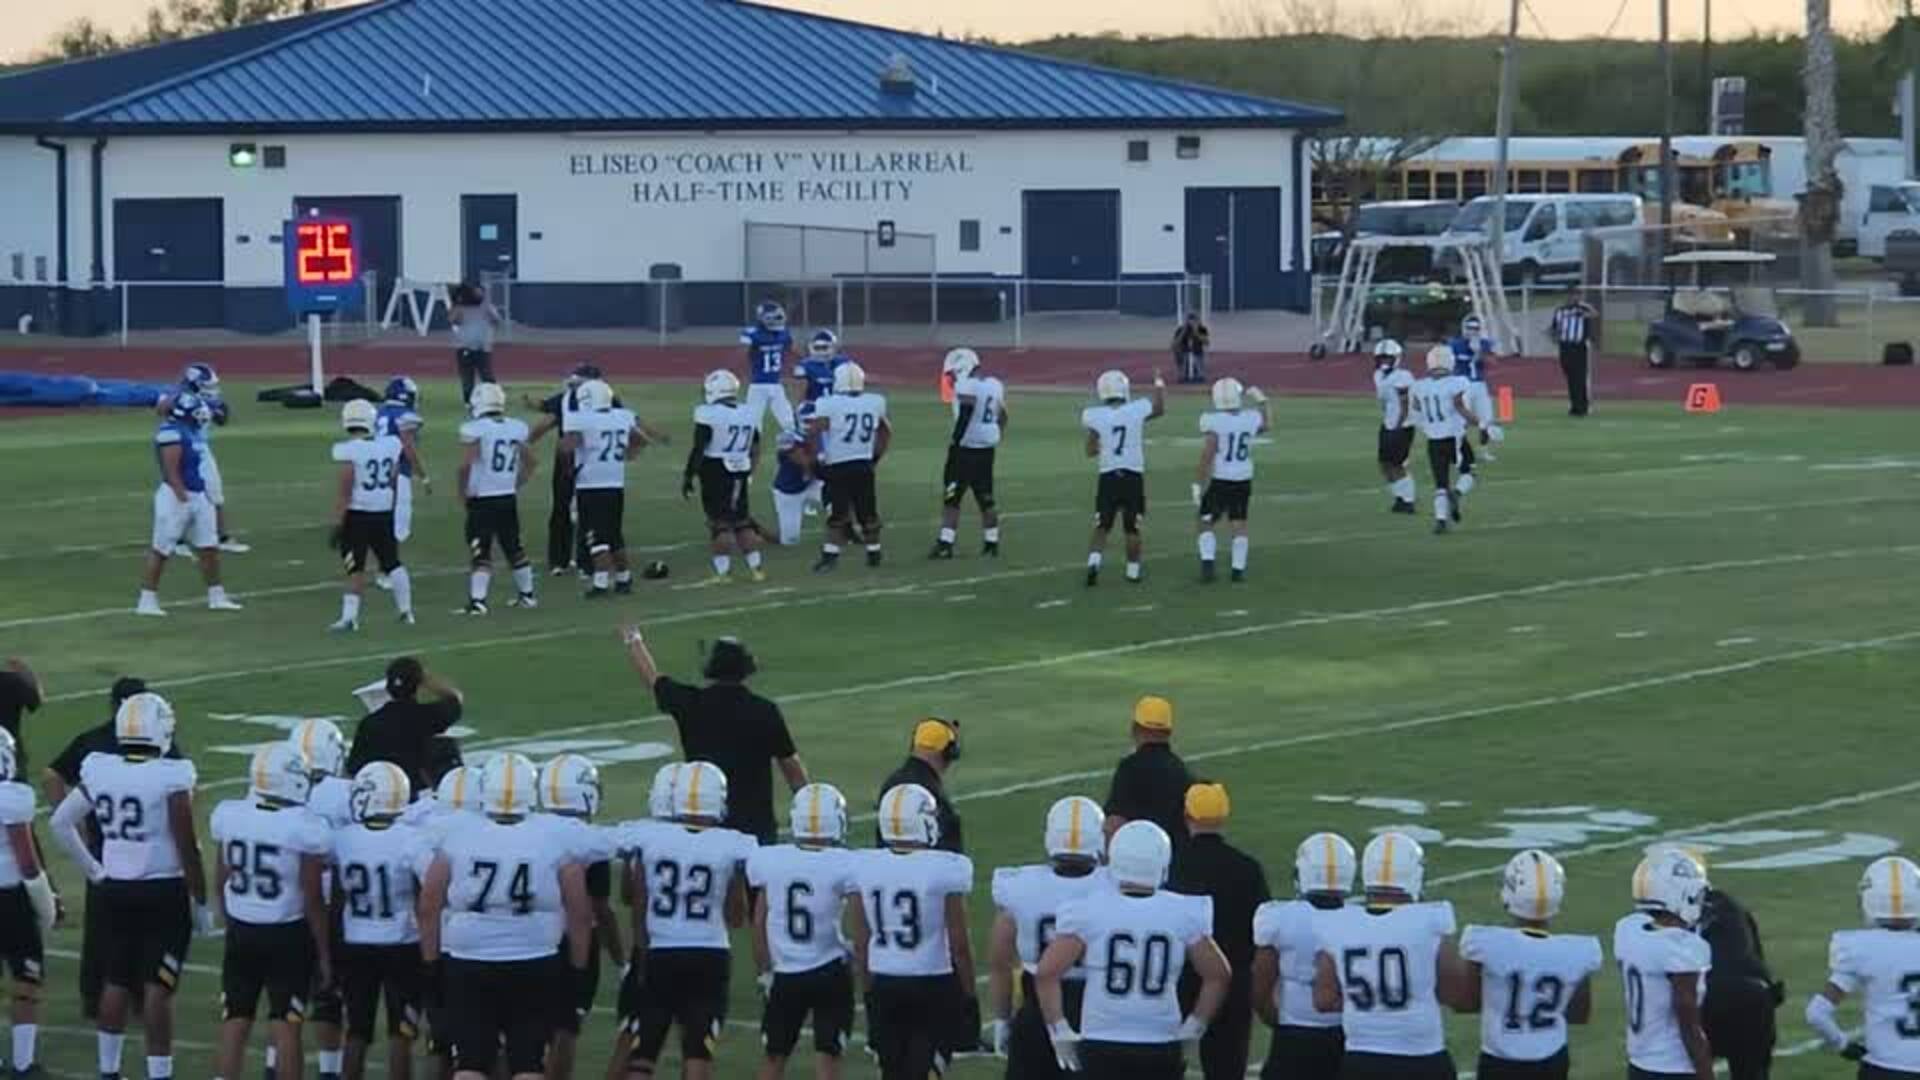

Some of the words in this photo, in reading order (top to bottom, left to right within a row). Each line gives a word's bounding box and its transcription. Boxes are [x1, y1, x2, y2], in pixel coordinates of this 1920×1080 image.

[570, 153, 658, 175] ELISEO
[812, 150, 973, 173] VILLARREAL
[633, 181, 784, 203] HALF-TIME
[799, 180, 913, 201] FACILITY
[298, 224, 352, 281] 25
[764, 351, 782, 372] 13
[983, 396, 993, 424] 6
[1692, 387, 1707, 407] G
[598, 430, 626, 462] 75
[844, 413, 874, 443] 79
[1112, 425, 1126, 456] 7
[1225, 432, 1249, 461] 16
[363, 457, 394, 490] 33
[96, 795, 143, 841] 22
[227, 839, 282, 899] 85
[347, 864, 393, 919] 21
[472, 861, 534, 914] 74
[652, 859, 712, 920] 32
[786, 882, 812, 942] 6
[871, 889, 919, 949] 13
[1106, 934, 1170, 996] 60
[1344, 947, 1408, 1010] 50
[1504, 972, 1561, 1030] 12
